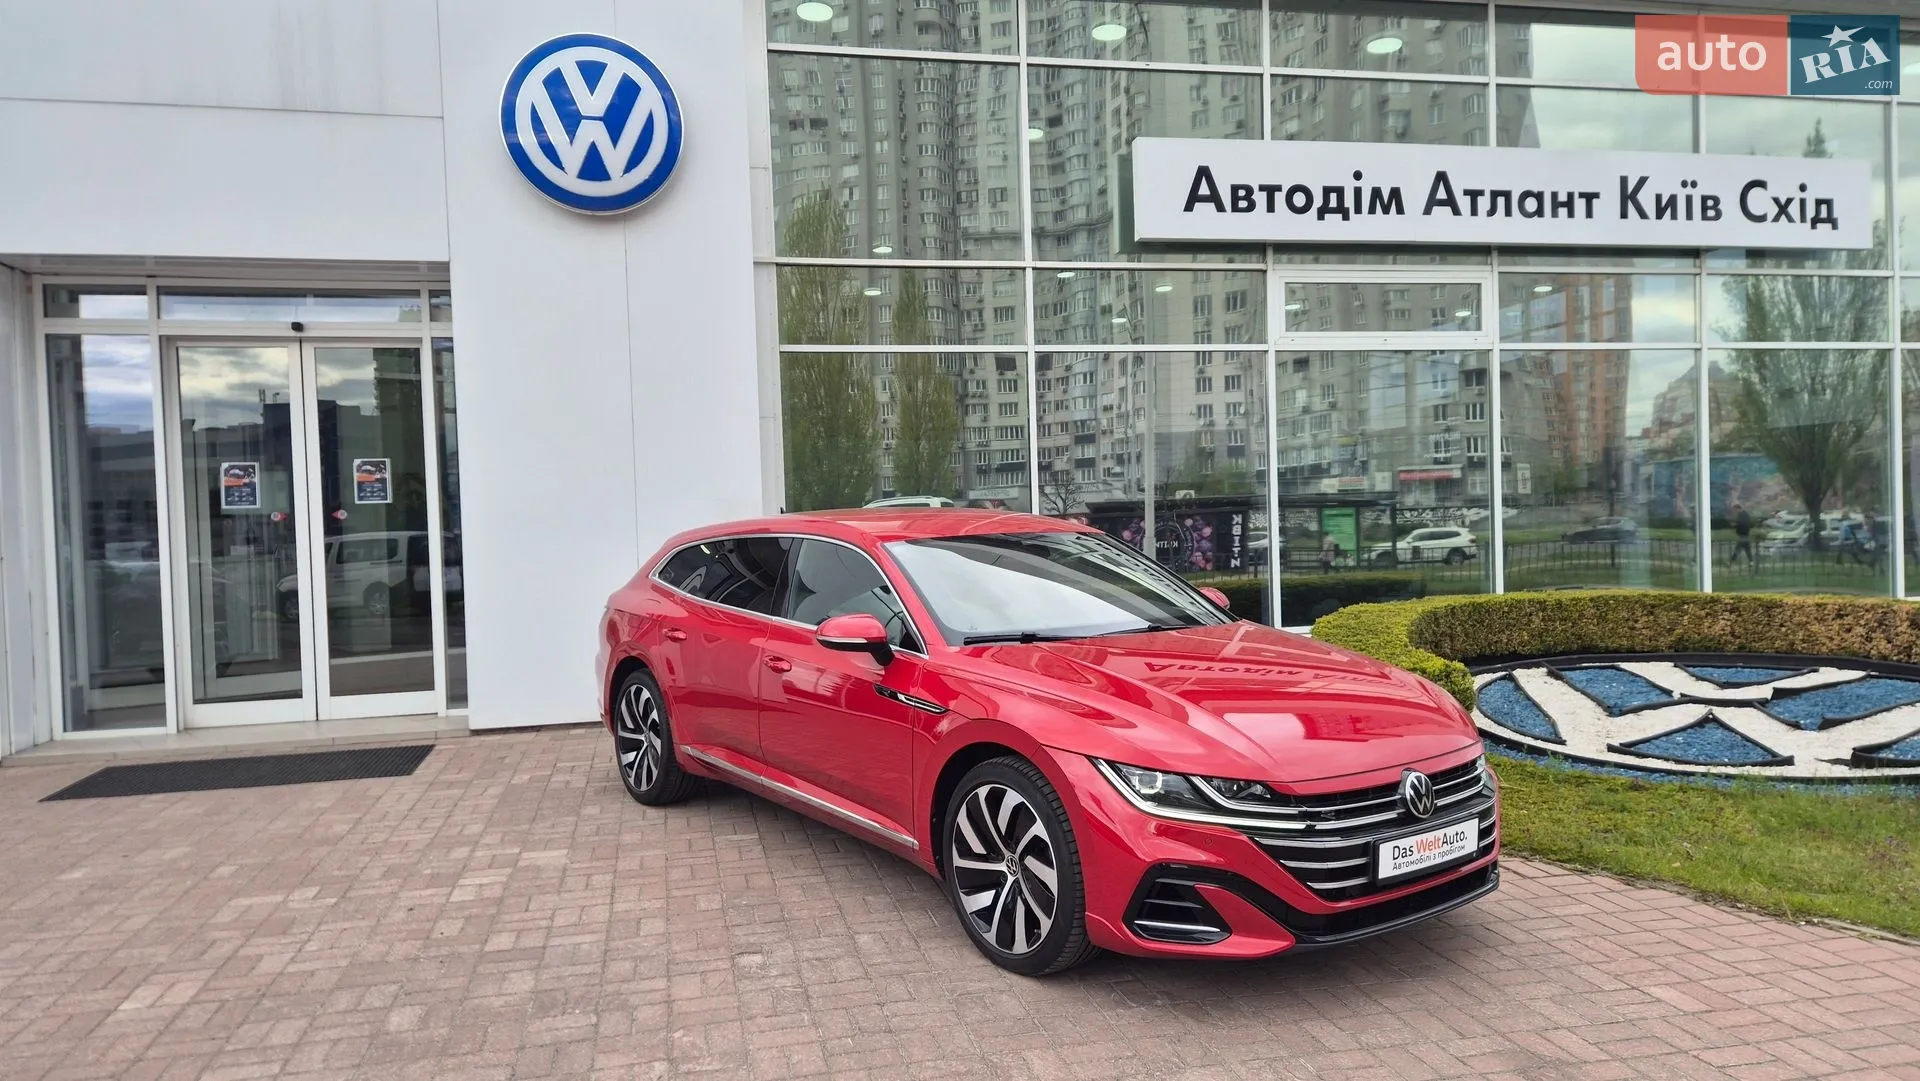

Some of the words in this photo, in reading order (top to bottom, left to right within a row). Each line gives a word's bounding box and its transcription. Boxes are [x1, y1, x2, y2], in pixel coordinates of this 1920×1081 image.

[1183, 165, 1406, 222] Автодім
[1422, 170, 1601, 219] Атлант
[1619, 175, 1723, 222] Київ
[1739, 179, 1839, 230] Схід
[1392, 845, 1414, 861] Das
[1392, 853, 1432, 871] Автомобілі
[1437, 844, 1466, 862] пробігом
